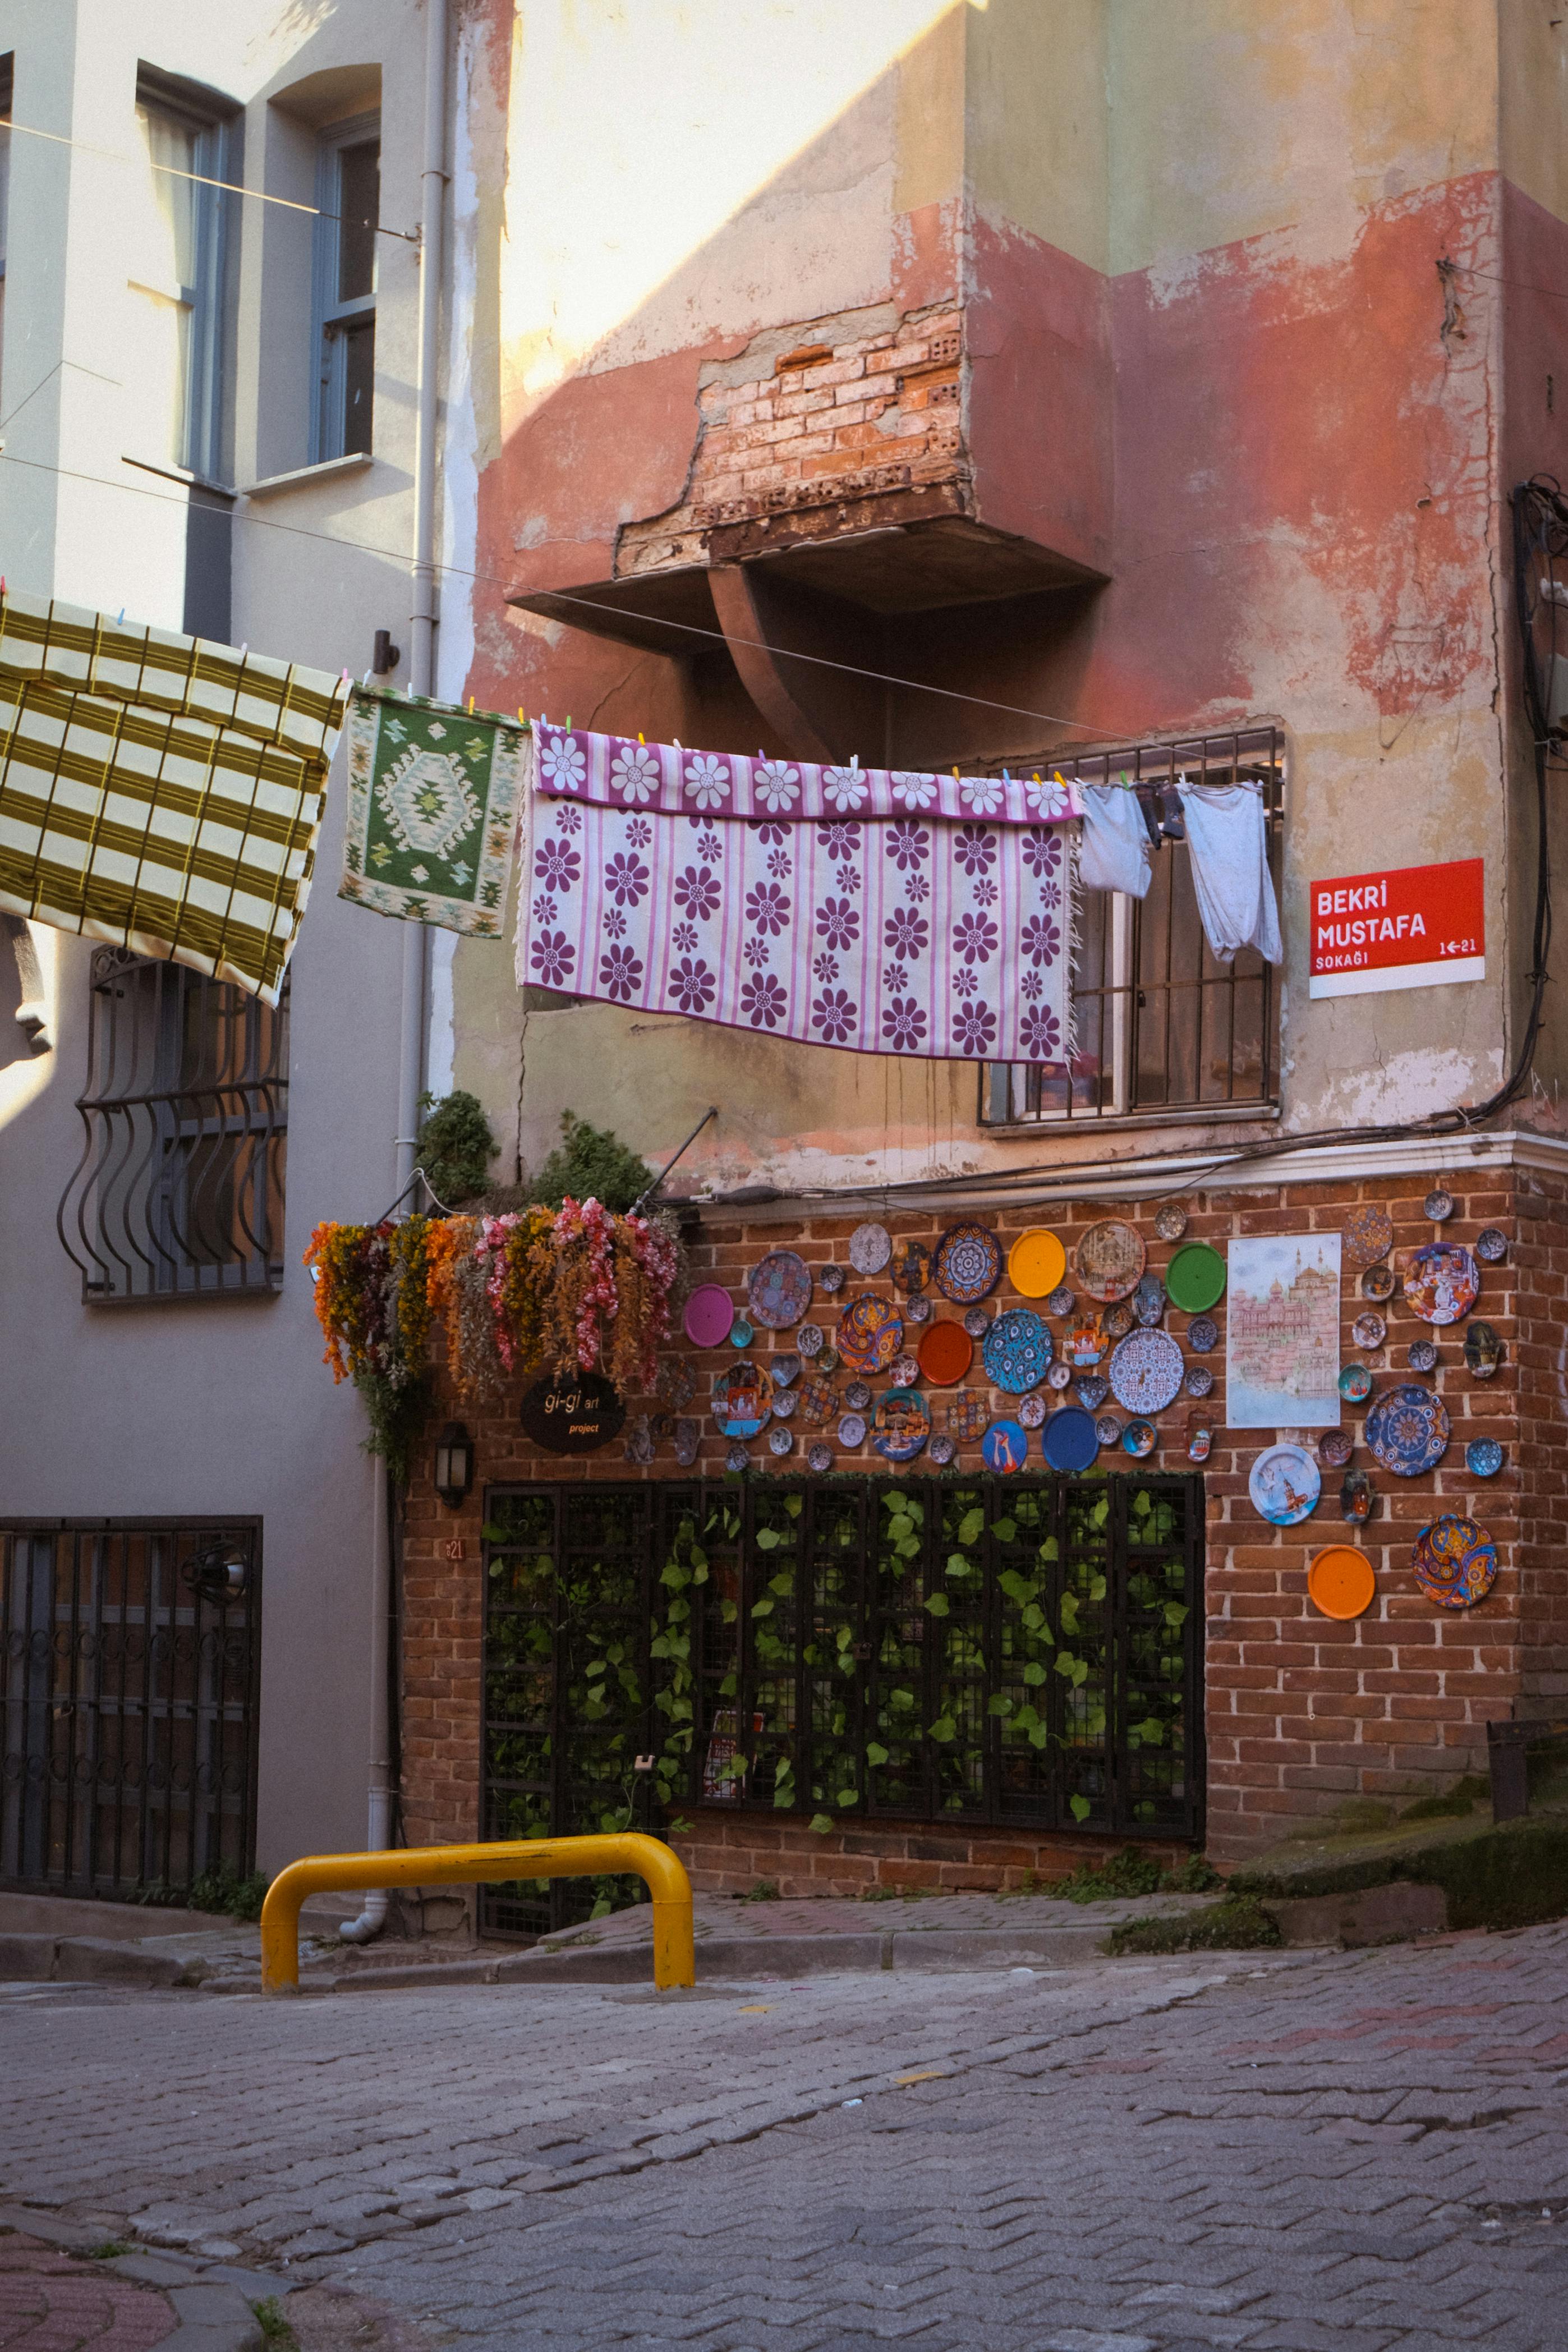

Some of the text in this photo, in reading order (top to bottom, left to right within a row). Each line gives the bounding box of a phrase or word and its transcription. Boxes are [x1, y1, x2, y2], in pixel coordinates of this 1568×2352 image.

[1318, 880, 1387, 916] BEKRİ
[1318, 913, 1426, 949] MUSTAFA
[1461, 939, 1476, 952] 21
[1316, 951, 1368, 970] SOKAĞI
[545, 1390, 600, 1413] gi-gi art
[569, 1423, 599, 1434] project
[451, 1540, 462, 1558] 21
